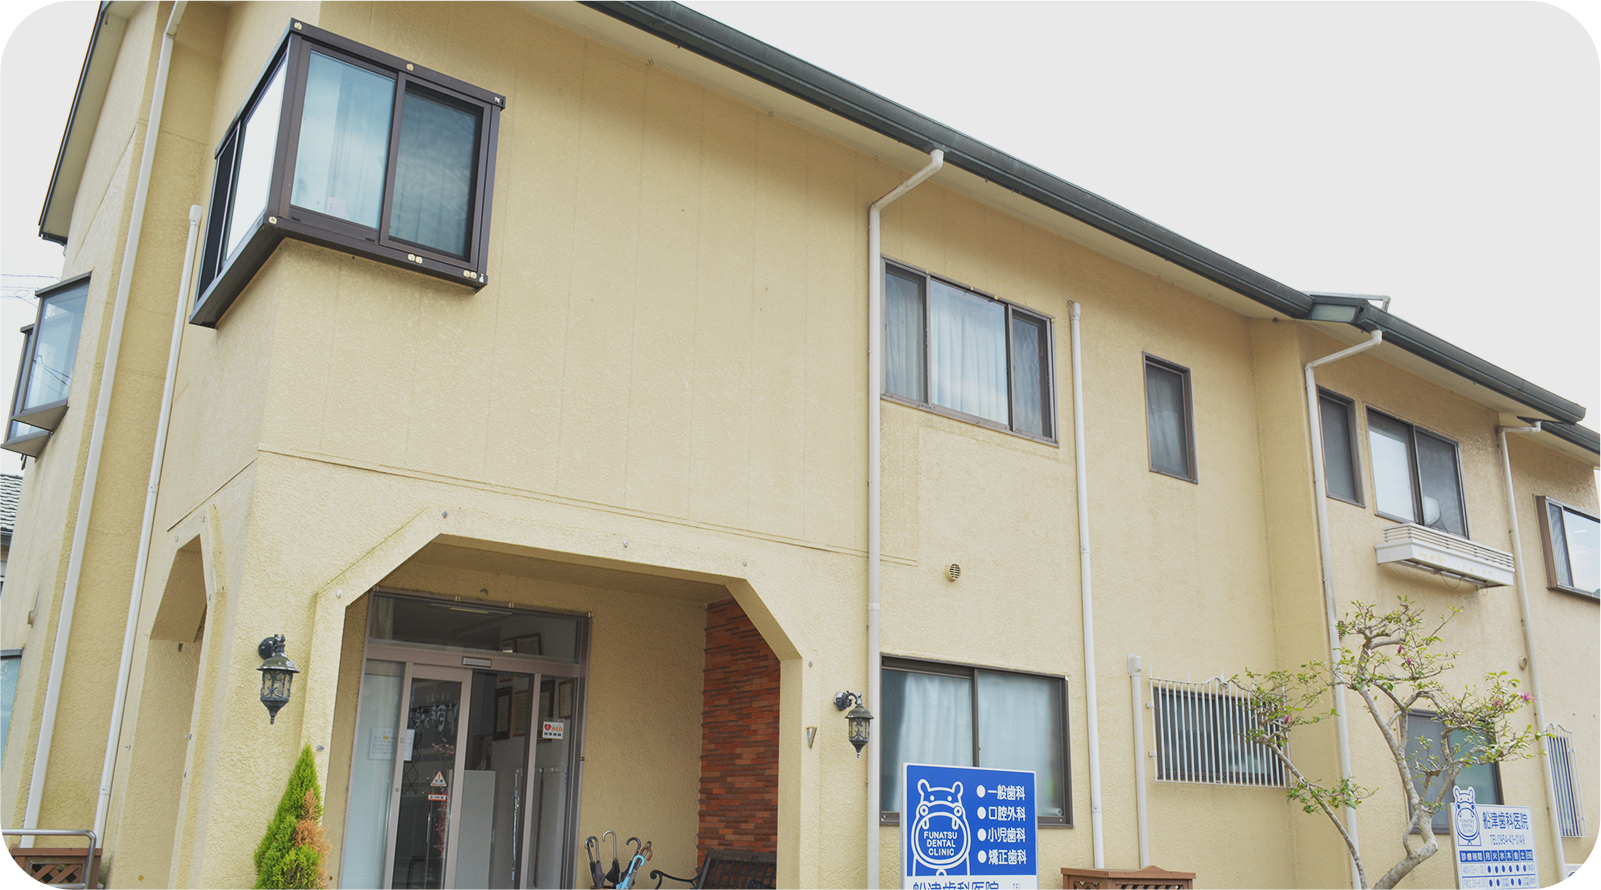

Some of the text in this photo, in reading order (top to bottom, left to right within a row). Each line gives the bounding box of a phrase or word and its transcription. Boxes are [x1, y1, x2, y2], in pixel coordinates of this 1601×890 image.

[987, 784, 1026, 801] 一般歯科
[988, 805, 1026, 822] 口腔外科
[1483, 811, 1529, 830] 船津歯科医院
[923, 831, 958, 839] FUNATSU
[987, 826, 1026, 843] 小児歯科
[926, 839, 956, 848] DENTAL
[928, 847, 955, 856] CLINIC
[988, 849, 1027, 865] 矯正歯科
